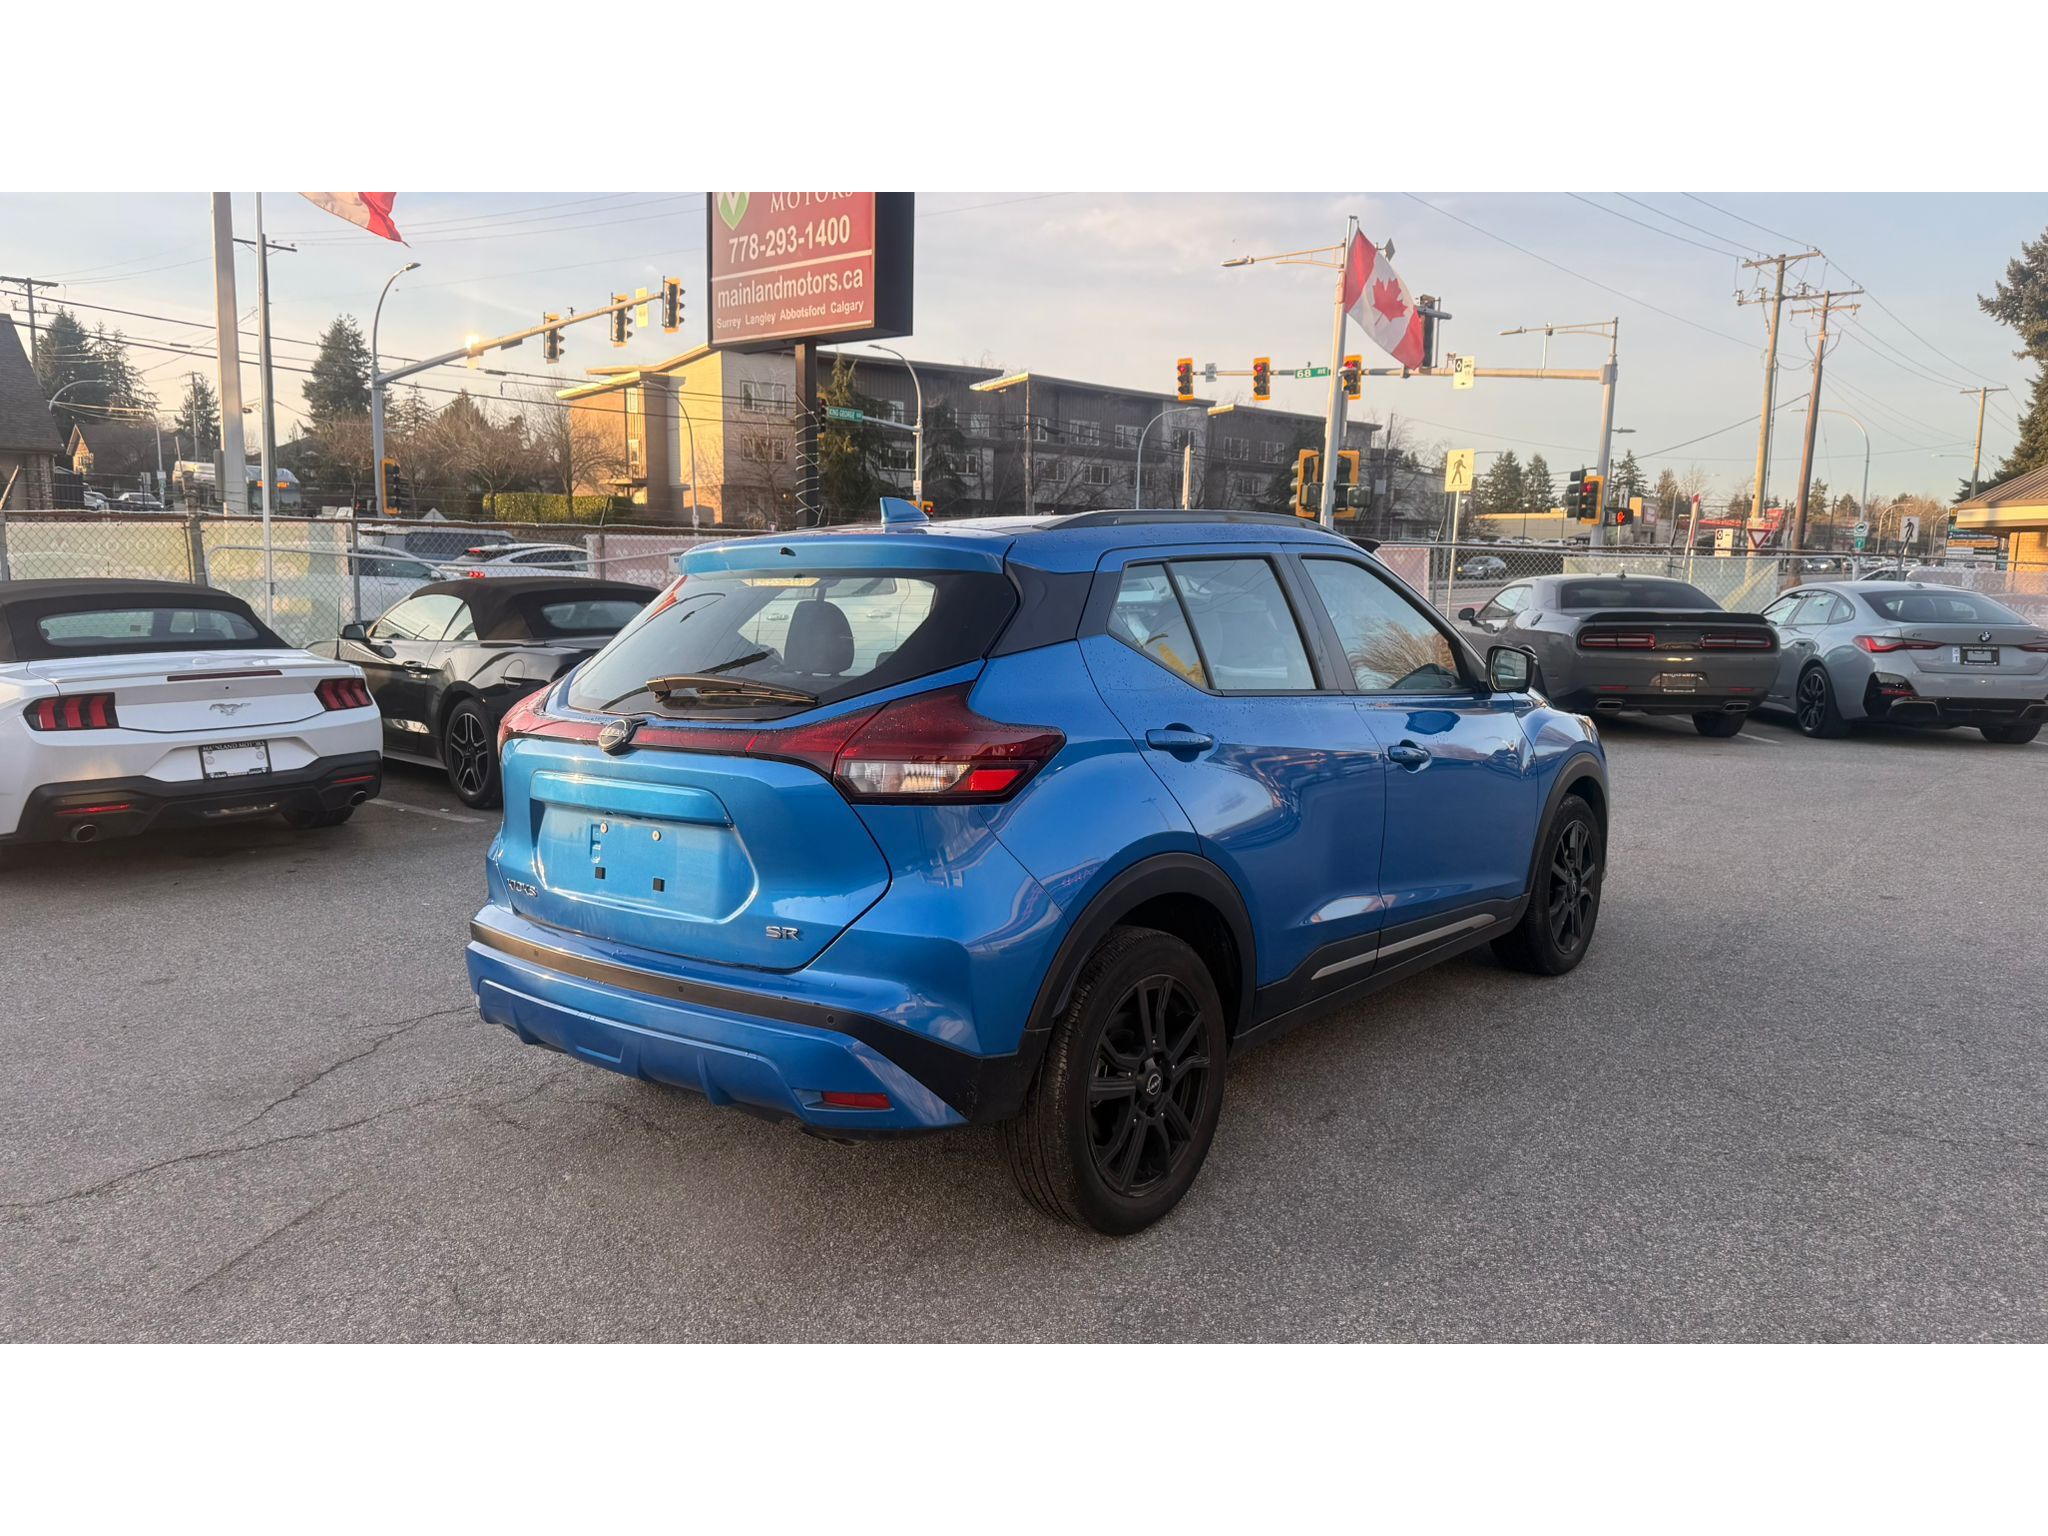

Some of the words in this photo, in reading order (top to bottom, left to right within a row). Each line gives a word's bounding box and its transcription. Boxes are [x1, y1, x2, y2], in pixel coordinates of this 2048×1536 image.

[770, 192, 853, 213] MOTO
[729, 214, 850, 264] 778-293-1400
[717, 268, 863, 309] mainlandmotors.ca
[716, 317, 742, 329] Surrey
[745, 311, 776, 326] Langley
[780, 303, 826, 321] Abbotsford
[830, 299, 864, 315] Calgary
[1297, 369, 1311, 378] 68
[765, 925, 800, 941] SR
